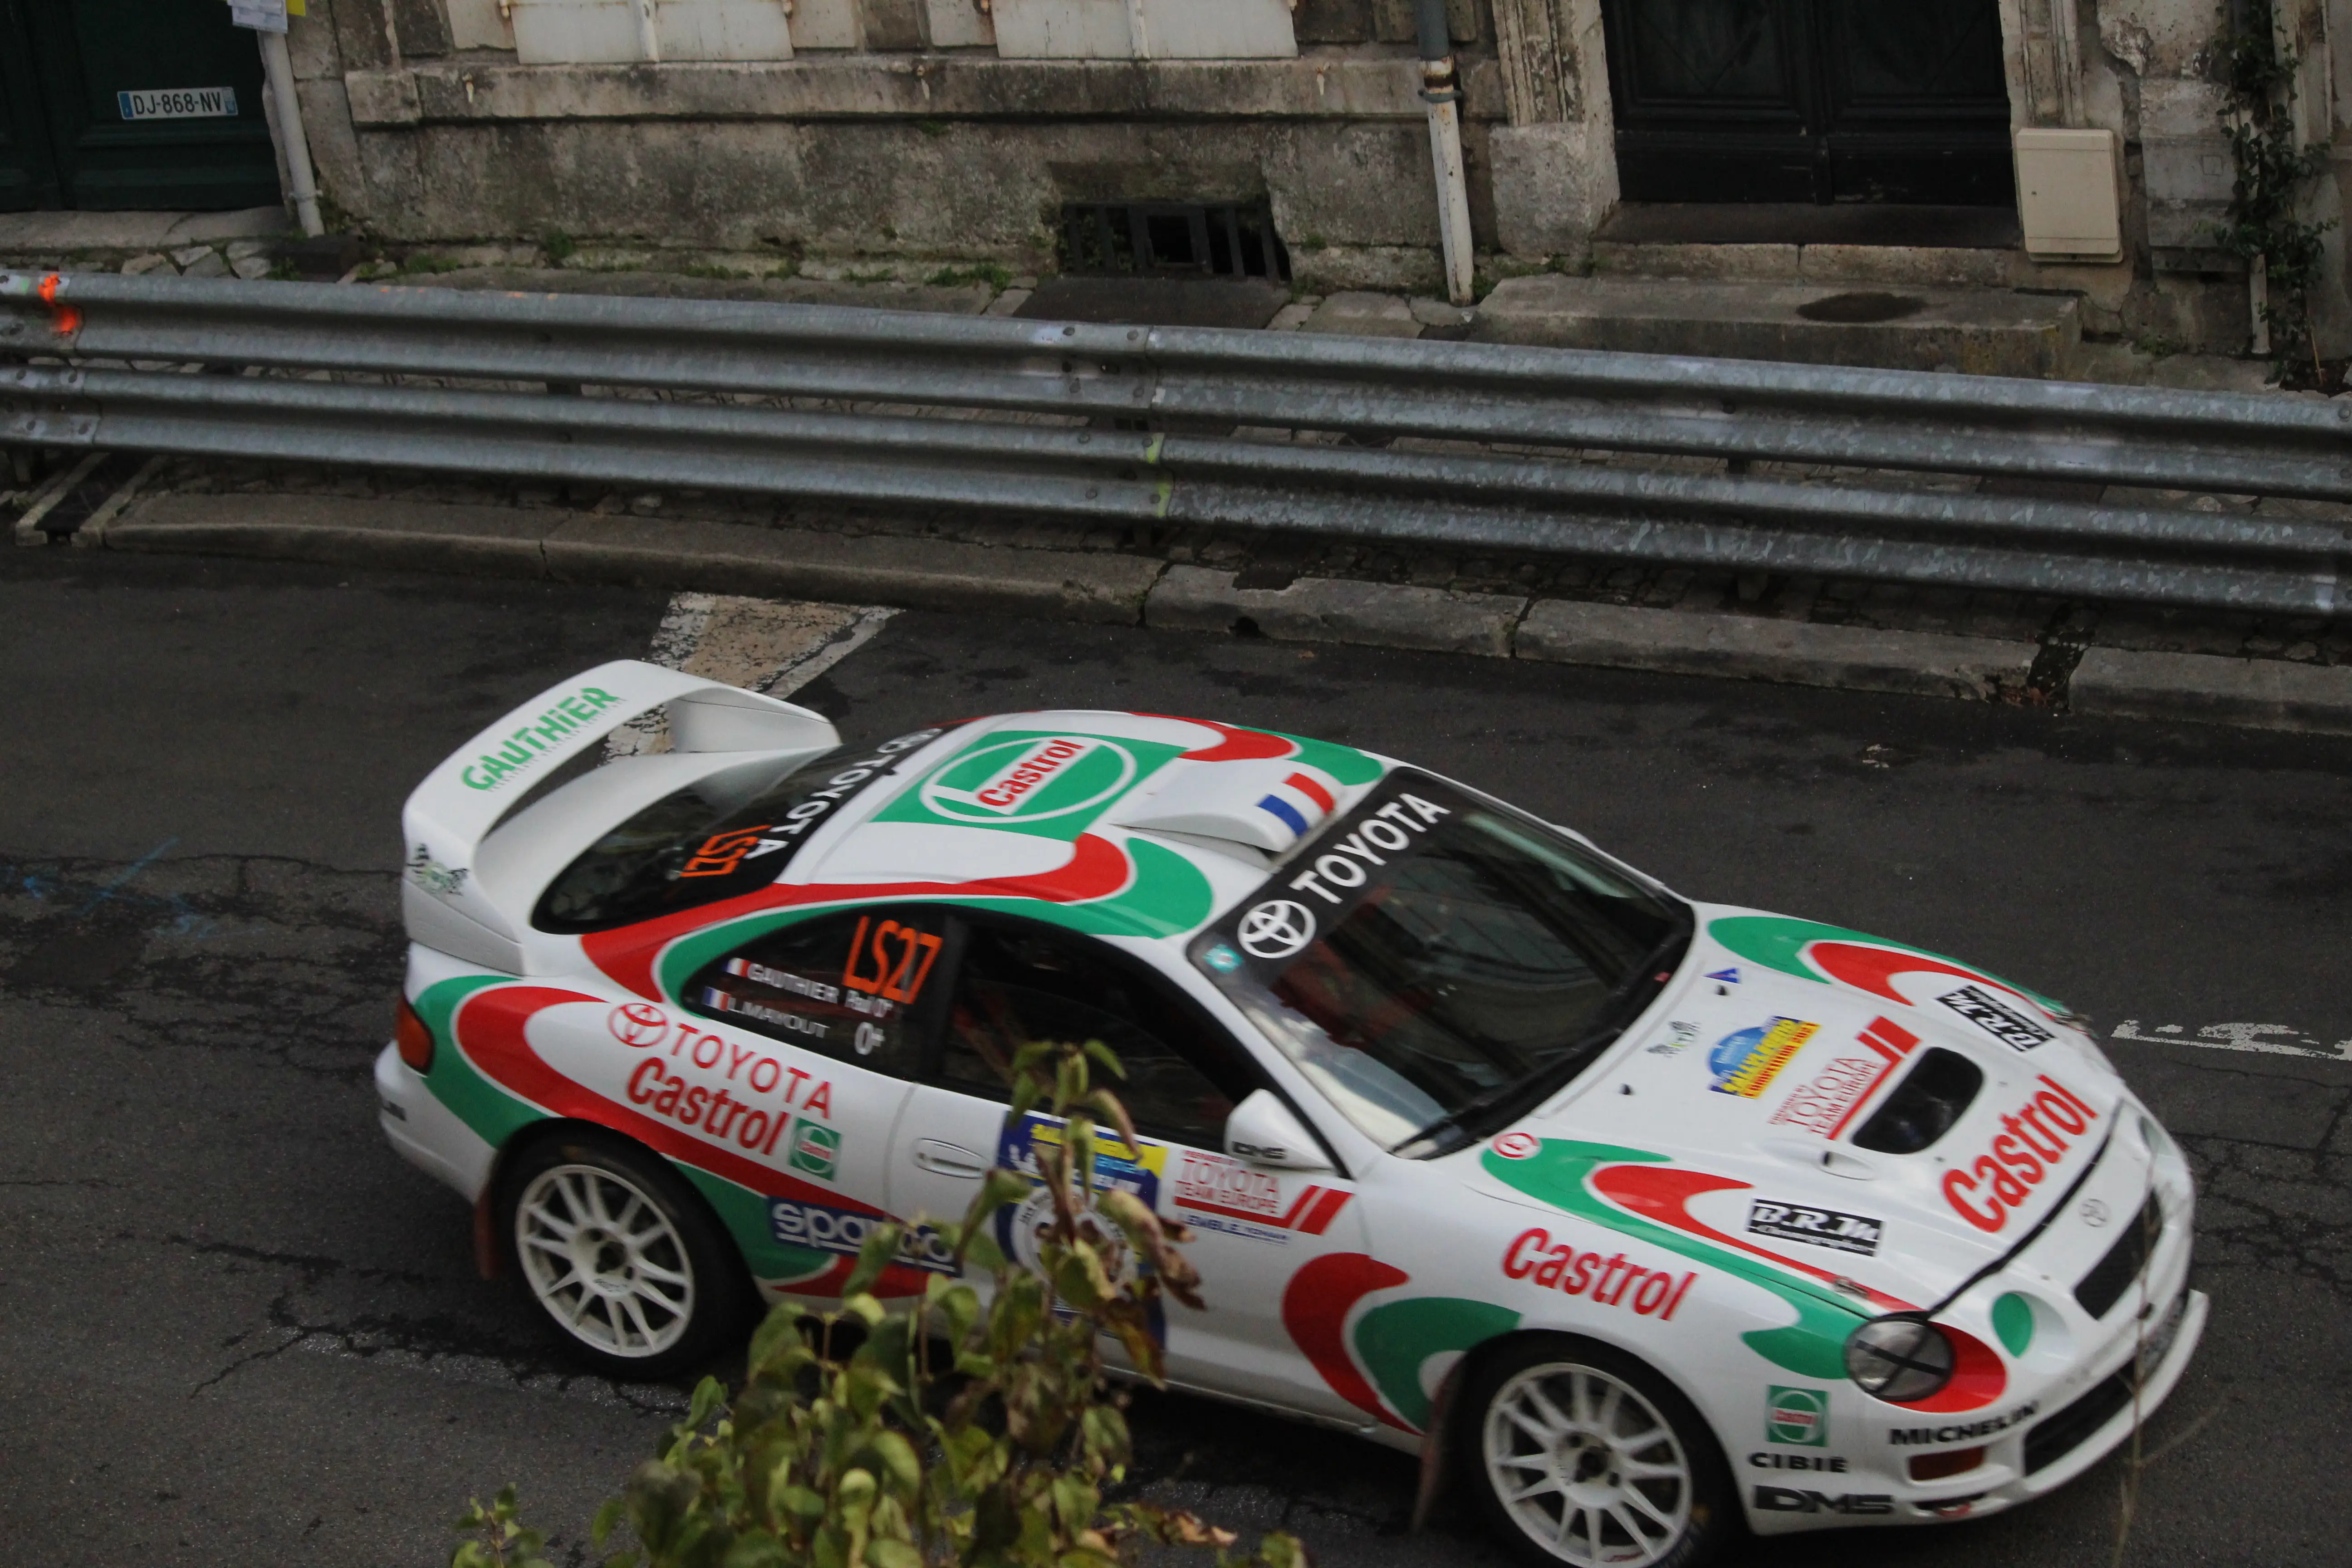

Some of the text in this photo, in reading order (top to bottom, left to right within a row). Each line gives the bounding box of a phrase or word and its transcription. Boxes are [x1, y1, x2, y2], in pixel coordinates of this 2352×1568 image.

[132, 92, 221, 114] DJ-868-NV
[743, 755, 897, 860] TOYOTA
[976, 739, 1085, 807] Castrol
[1289, 793, 1451, 904] TOYOTA
[627, 1056, 791, 1156] Castrol
[669, 1022, 833, 1120] TOYOTA
[1781, 1058, 1867, 1126] TOYOTA
[1806, 1060, 1883, 1135] TEAM EUROPE
[1181, 1158, 1280, 1200] TOYOTA
[1941, 1073, 2099, 1233] Castrol
[1502, 1227, 1699, 1321] Castrol
[1889, 1400, 2039, 1445] MICHELIN
[1754, 1485, 1895, 1514] DMS
